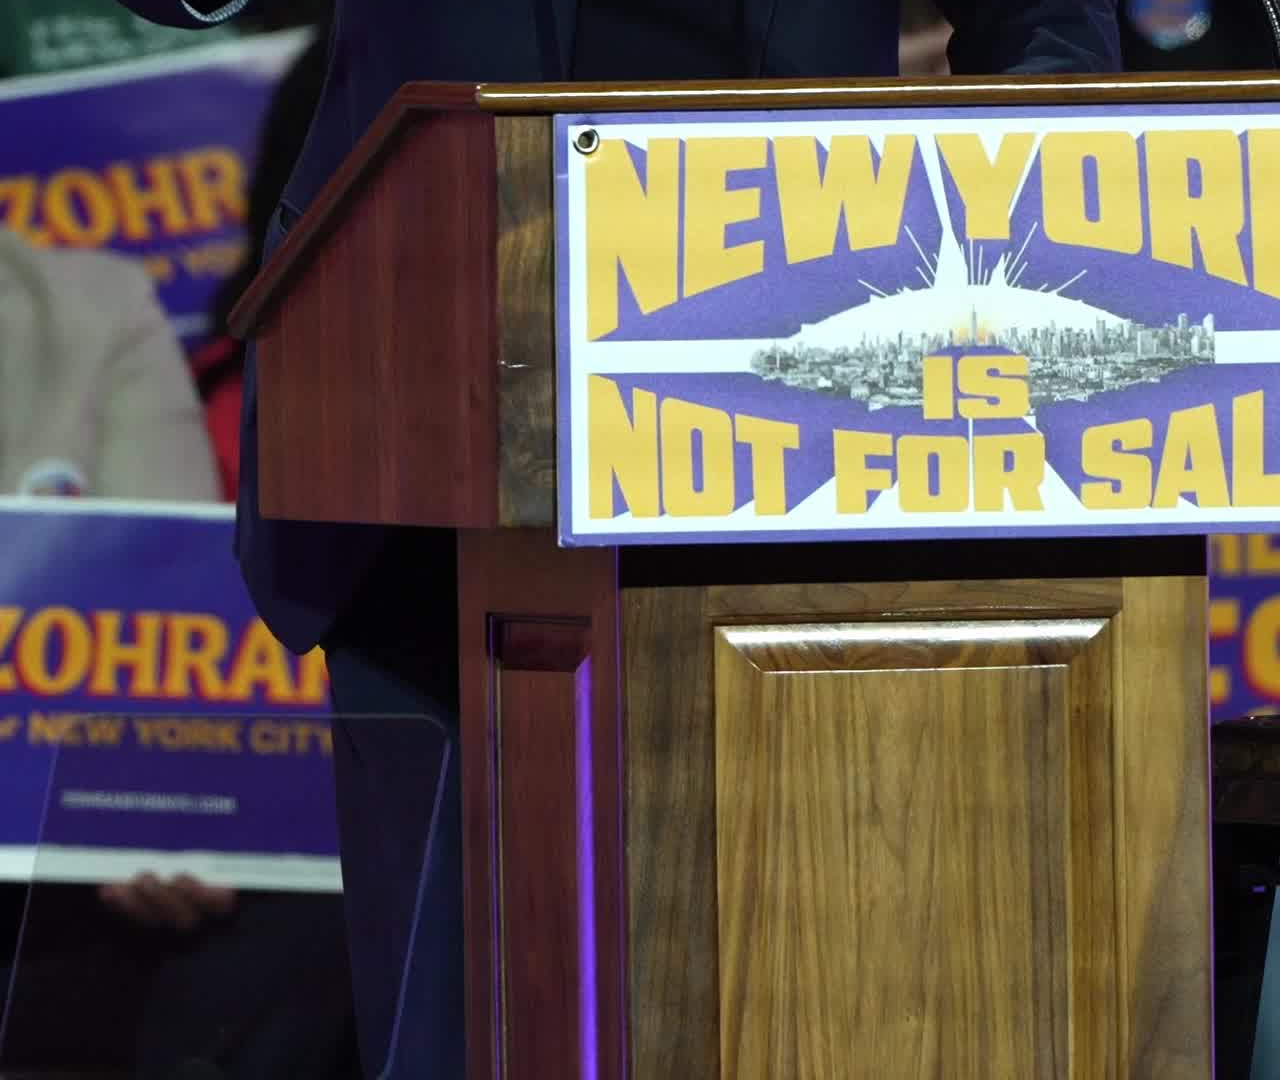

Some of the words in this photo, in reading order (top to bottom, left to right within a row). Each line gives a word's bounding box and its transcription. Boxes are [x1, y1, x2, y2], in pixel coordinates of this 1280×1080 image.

[584, 133, 917, 340] NEW
[923, 354, 1031, 420] IS
[587, 372, 800, 519] NOT
[832, 429, 1047, 515] FOR
[26, 711, 124, 748] NEW
[133, 718, 244, 754] YORK
